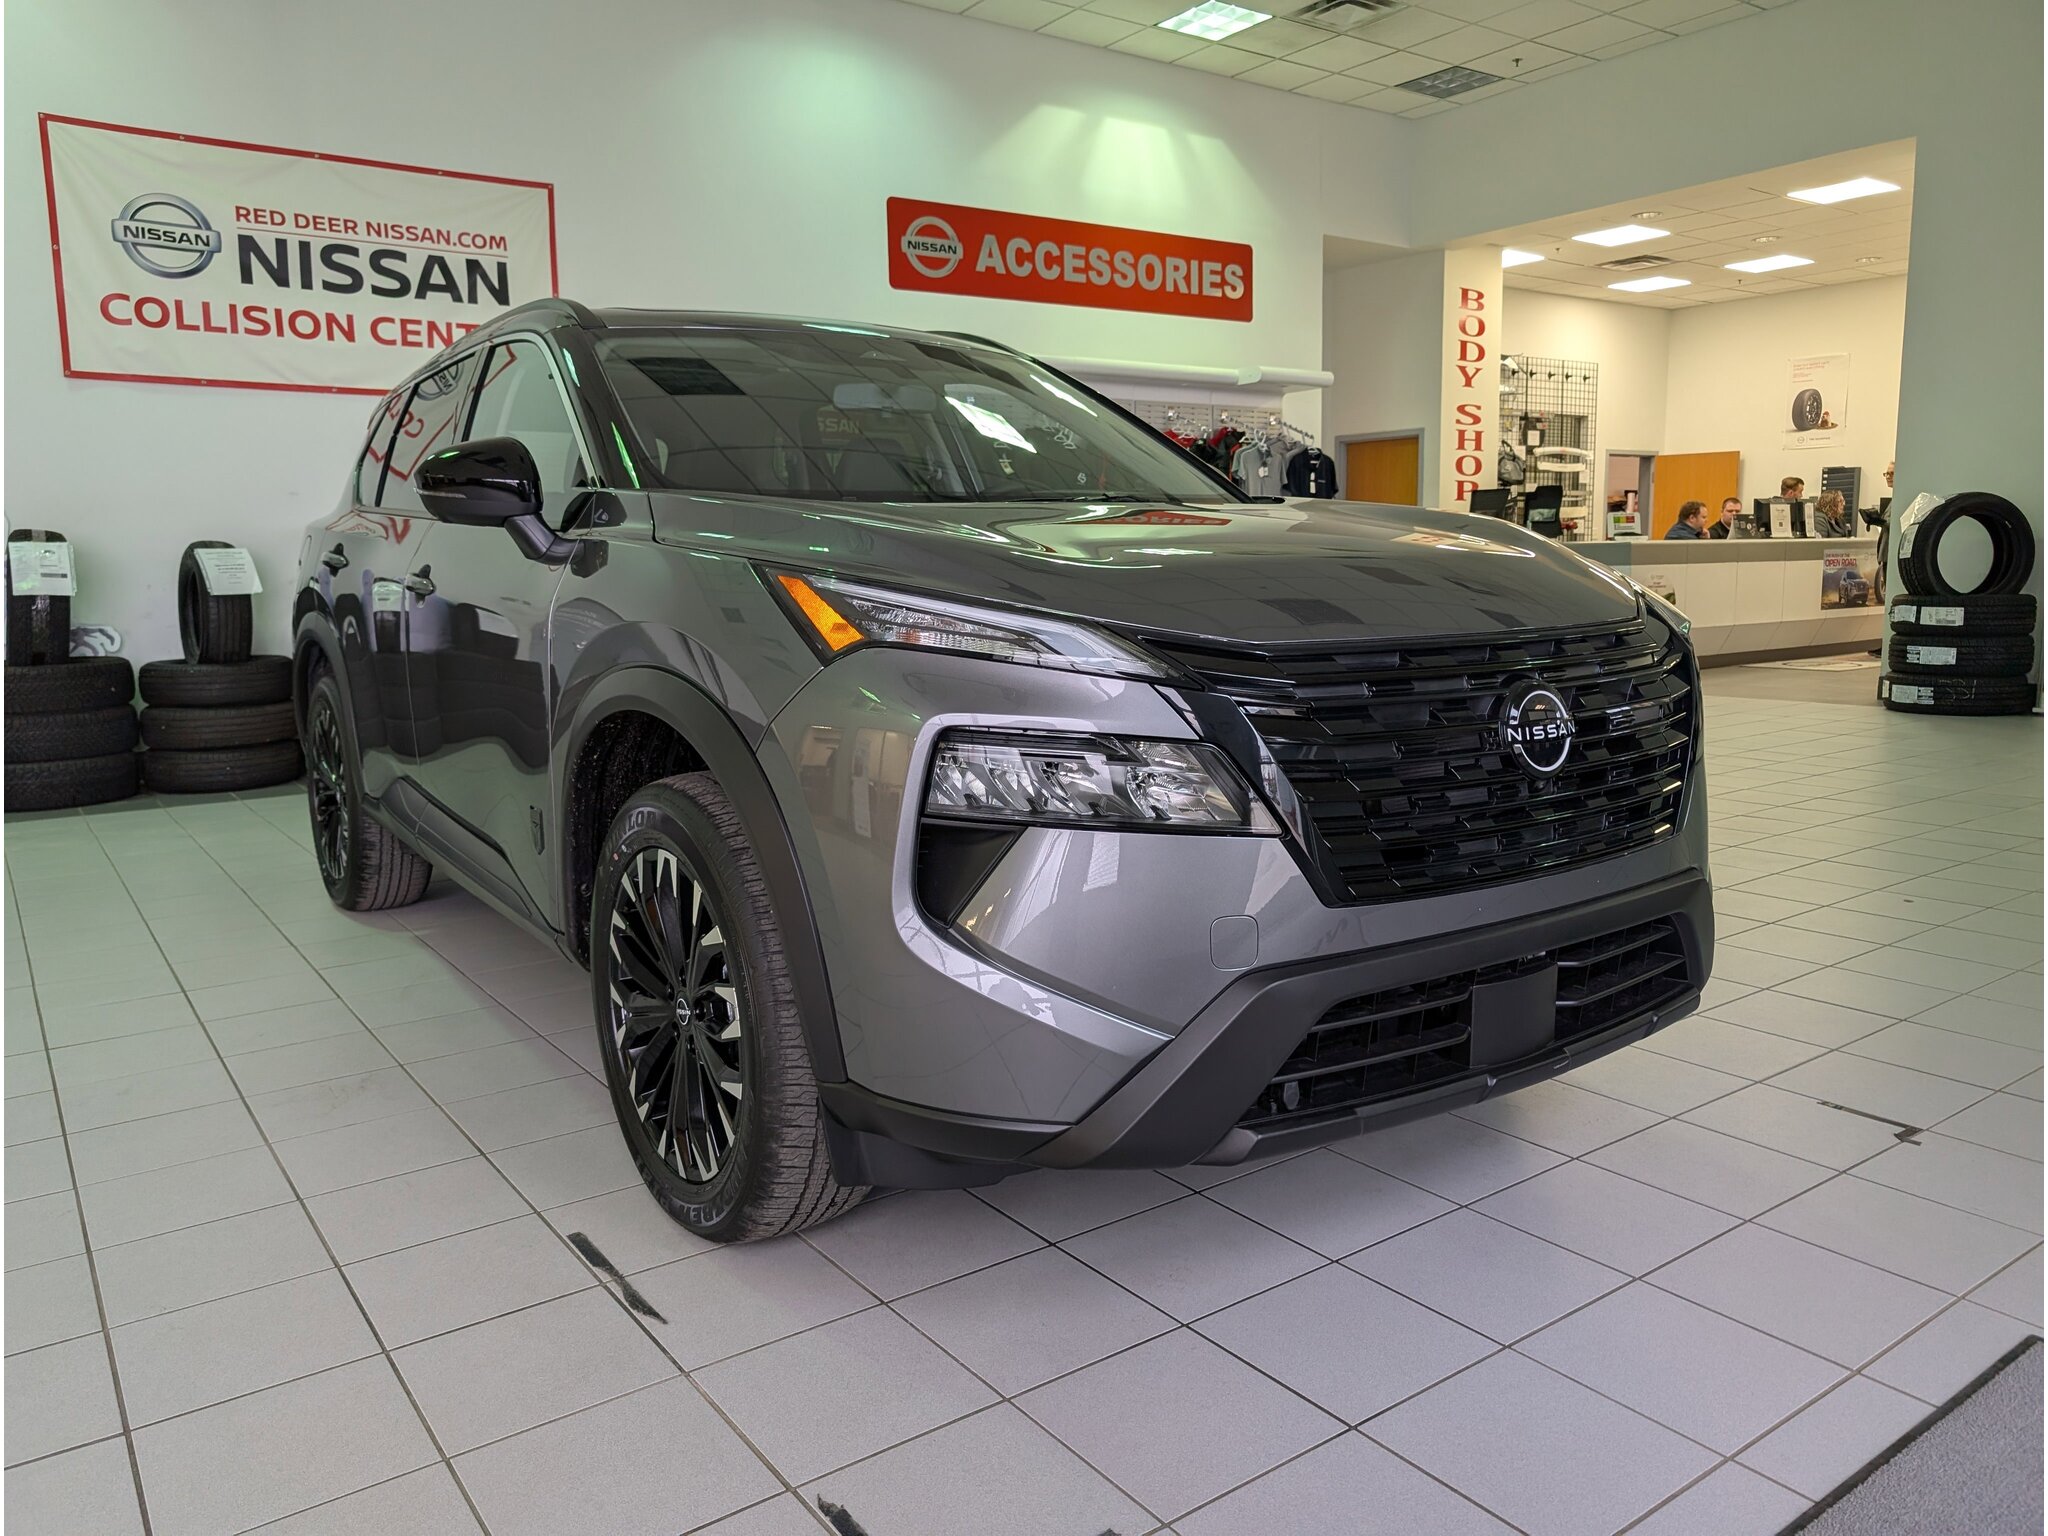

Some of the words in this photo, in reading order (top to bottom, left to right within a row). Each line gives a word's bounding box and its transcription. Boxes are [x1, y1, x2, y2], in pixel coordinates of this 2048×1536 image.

[123, 225, 211, 247] NISSAN
[235, 205, 286, 226] RED
[294, 212, 359, 235] DEER
[365, 221, 508, 252] NISSAN.COM
[906, 240, 958, 255] NISSAN
[237, 234, 511, 307] NISSAN
[975, 233, 1245, 300] ACCESSORIES
[100, 292, 356, 344] COLLISION
[1456, 286, 1486, 389] BODY
[1454, 403, 1485, 502] SHOP
[1506, 720, 1576, 742] NISSAN
